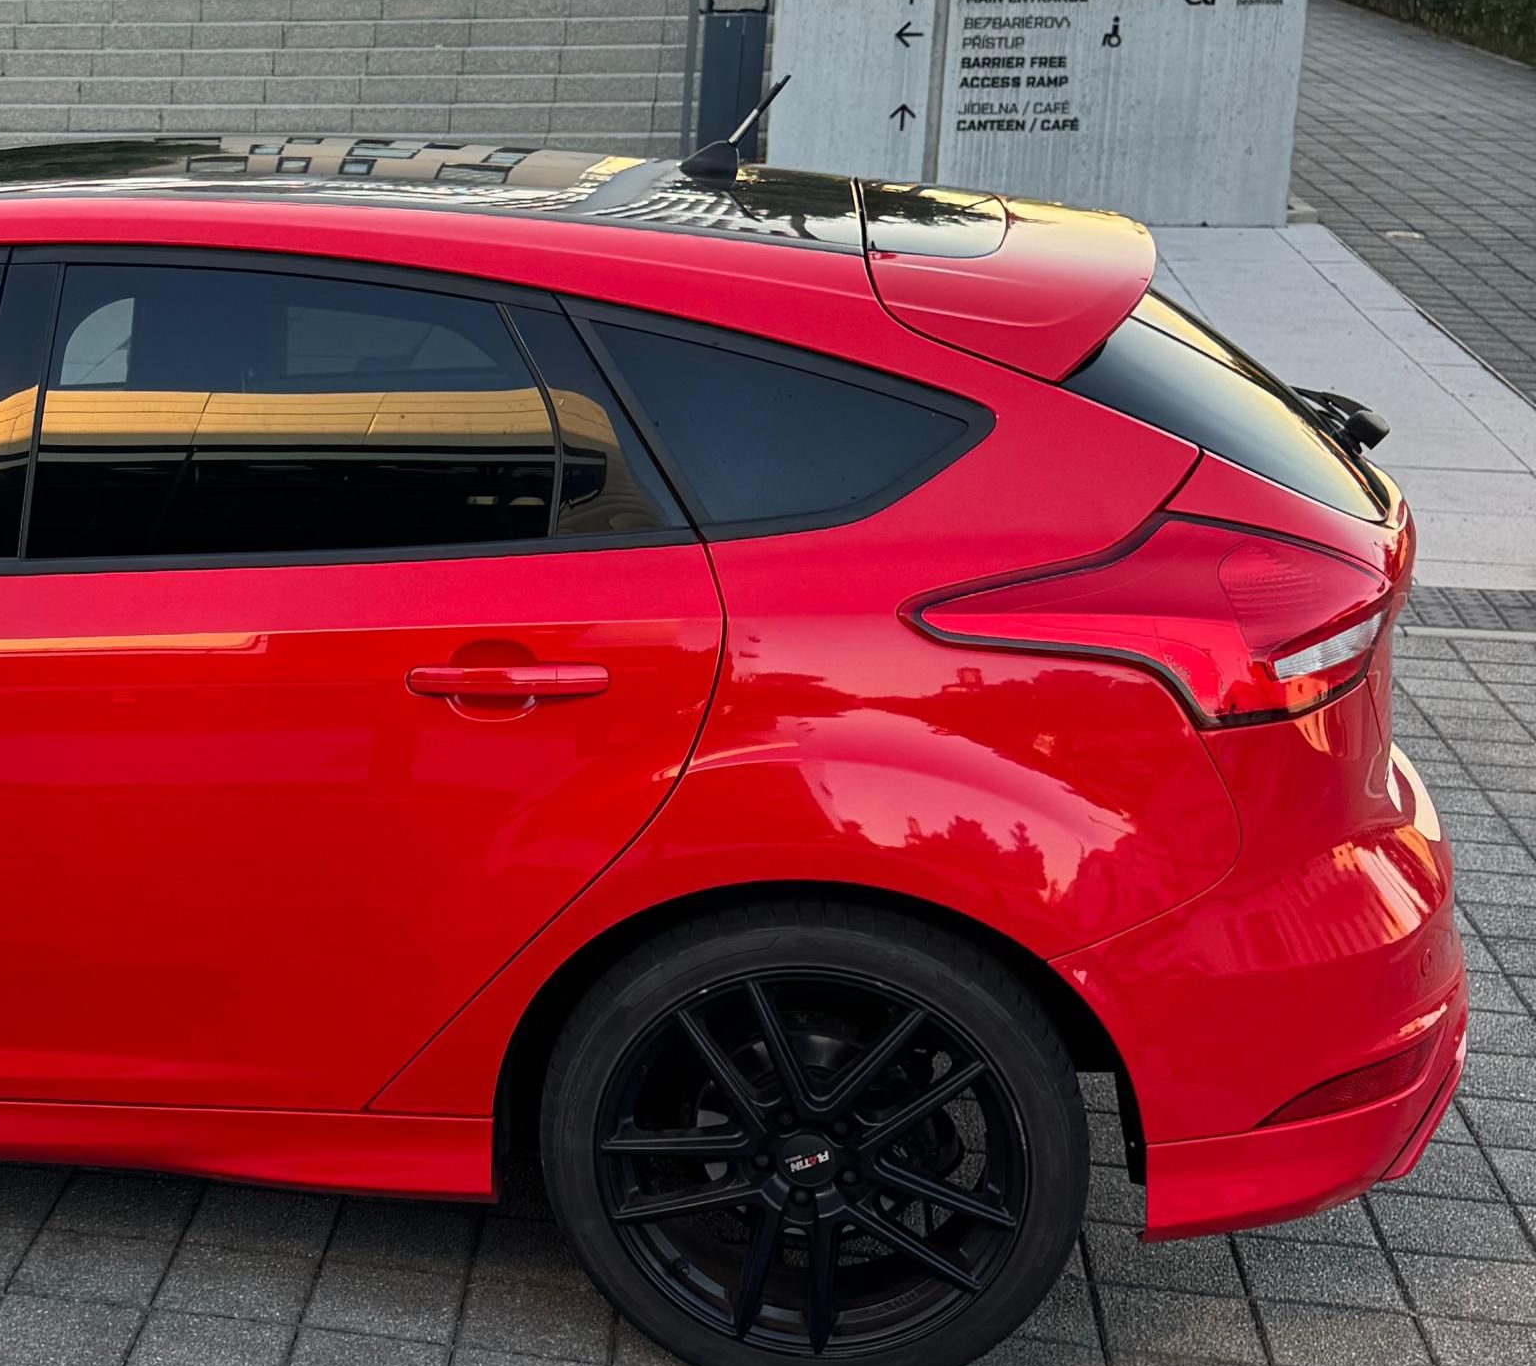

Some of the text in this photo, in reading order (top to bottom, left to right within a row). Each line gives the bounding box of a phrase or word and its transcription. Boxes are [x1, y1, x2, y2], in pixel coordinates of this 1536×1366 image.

[961, 56, 1067, 69] BARRIER FREE
[959, 76, 1069, 88] ACCESS RAMP
[1033, 100, 1070, 115] CAFÉ
[956, 116, 1079, 133] CANTEEN / CAFÉ
